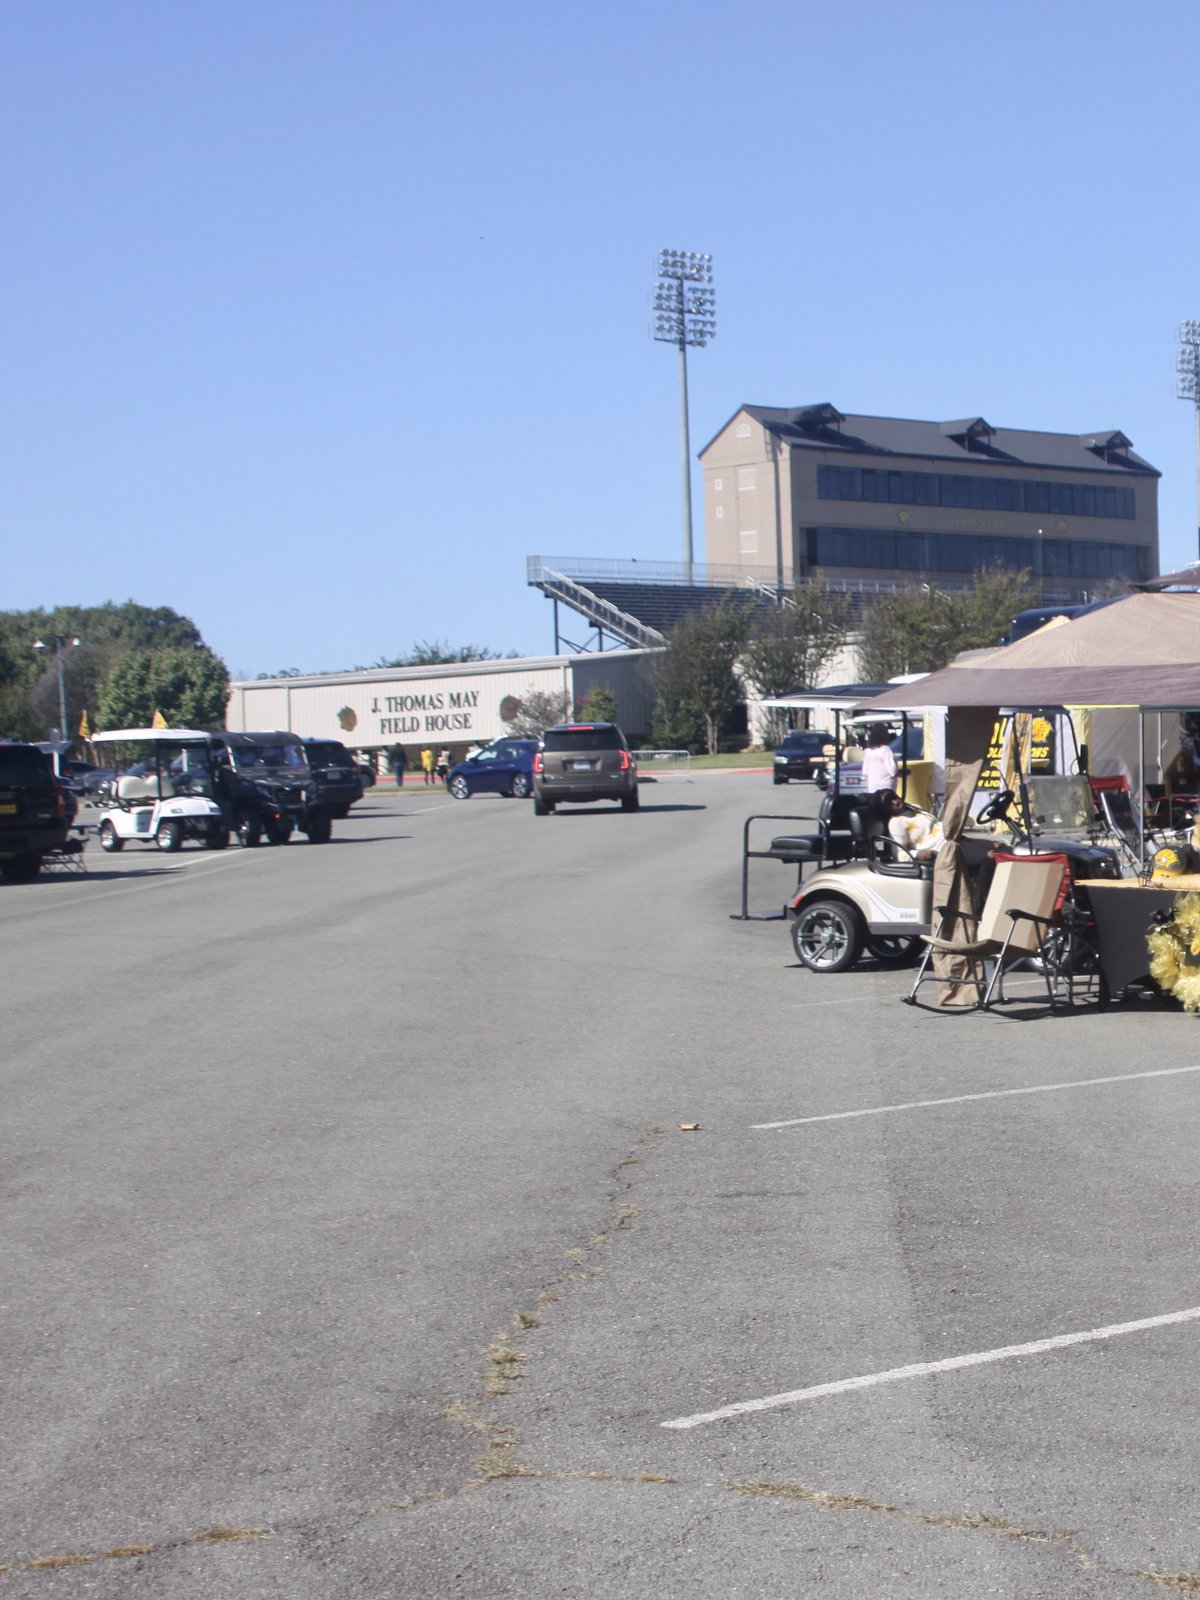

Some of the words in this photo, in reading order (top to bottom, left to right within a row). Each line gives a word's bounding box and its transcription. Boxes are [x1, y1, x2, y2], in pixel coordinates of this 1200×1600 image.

[371, 697, 381, 713] J.
[385, 693, 444, 712] THOMAS
[449, 690, 480, 708] MAY
[380, 717, 420, 735] FIELD
[425, 713, 472, 732] HOUSE
